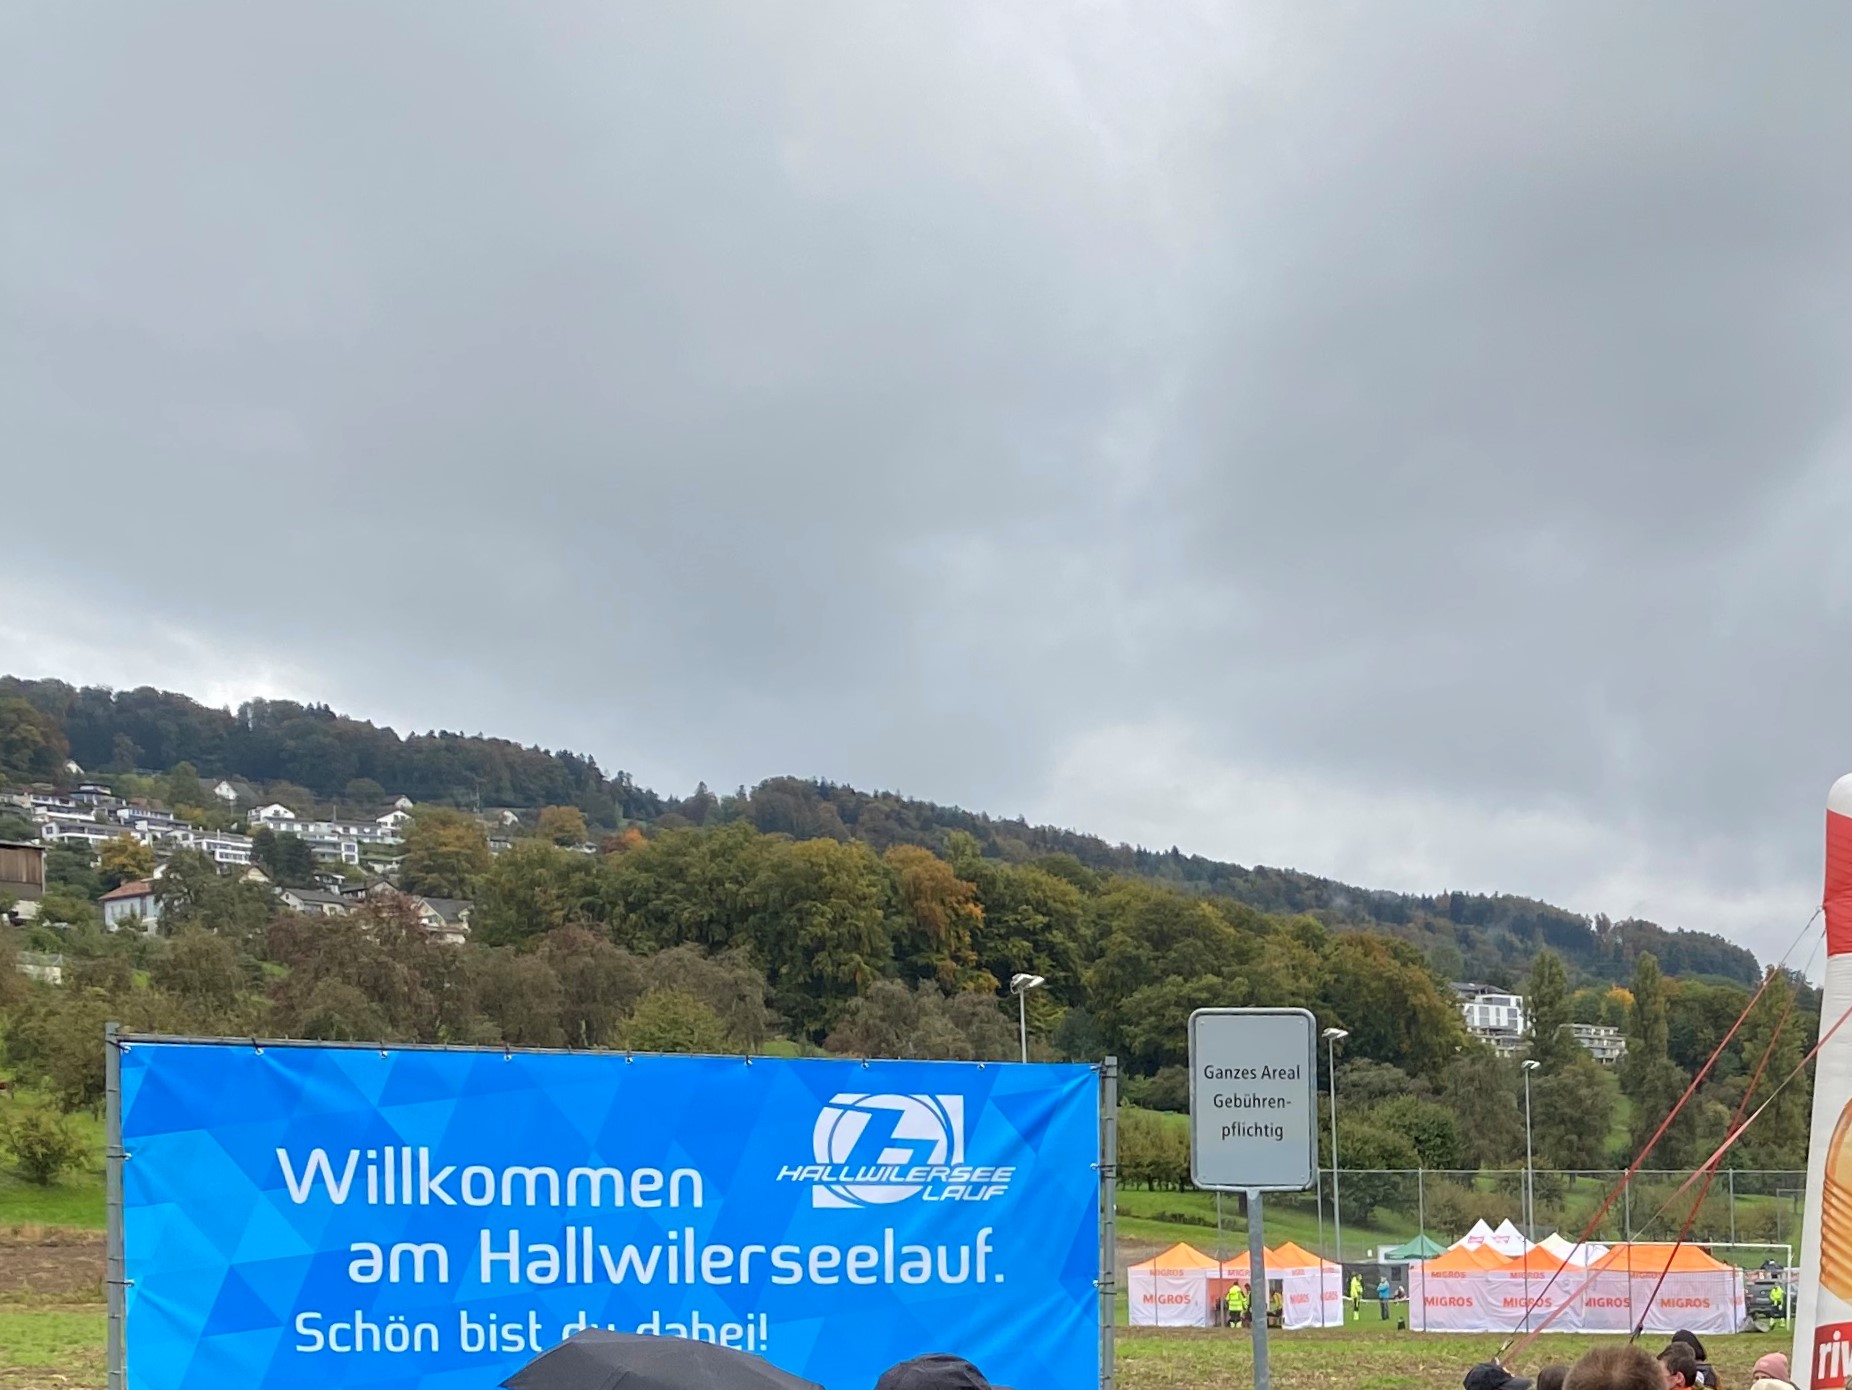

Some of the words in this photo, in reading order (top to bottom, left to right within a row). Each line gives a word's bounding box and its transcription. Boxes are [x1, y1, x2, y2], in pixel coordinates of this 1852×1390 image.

[1204, 1064, 1257, 1080] Ganzes
[1261, 1064, 1300, 1080] Areal
[1213, 1092, 1292, 1109] Gebühren-
[1222, 1121, 1284, 1142] pflichtig
[276, 1146, 702, 1207] Willkommen
[776, 1165, 1016, 1183] HALLWILERSEE
[922, 1185, 1008, 1201] LAUF
[348, 1242, 449, 1284] am
[480, 1226, 1005, 1285] Hallwilerseelauf.
[1143, 1294, 1191, 1304] MGROS
[1424, 1297, 1473, 1307] MIGROS
[1660, 1297, 1710, 1308] MIGROS
[295, 1310, 439, 1352] Schön
[460, 1310, 542, 1352] bist
